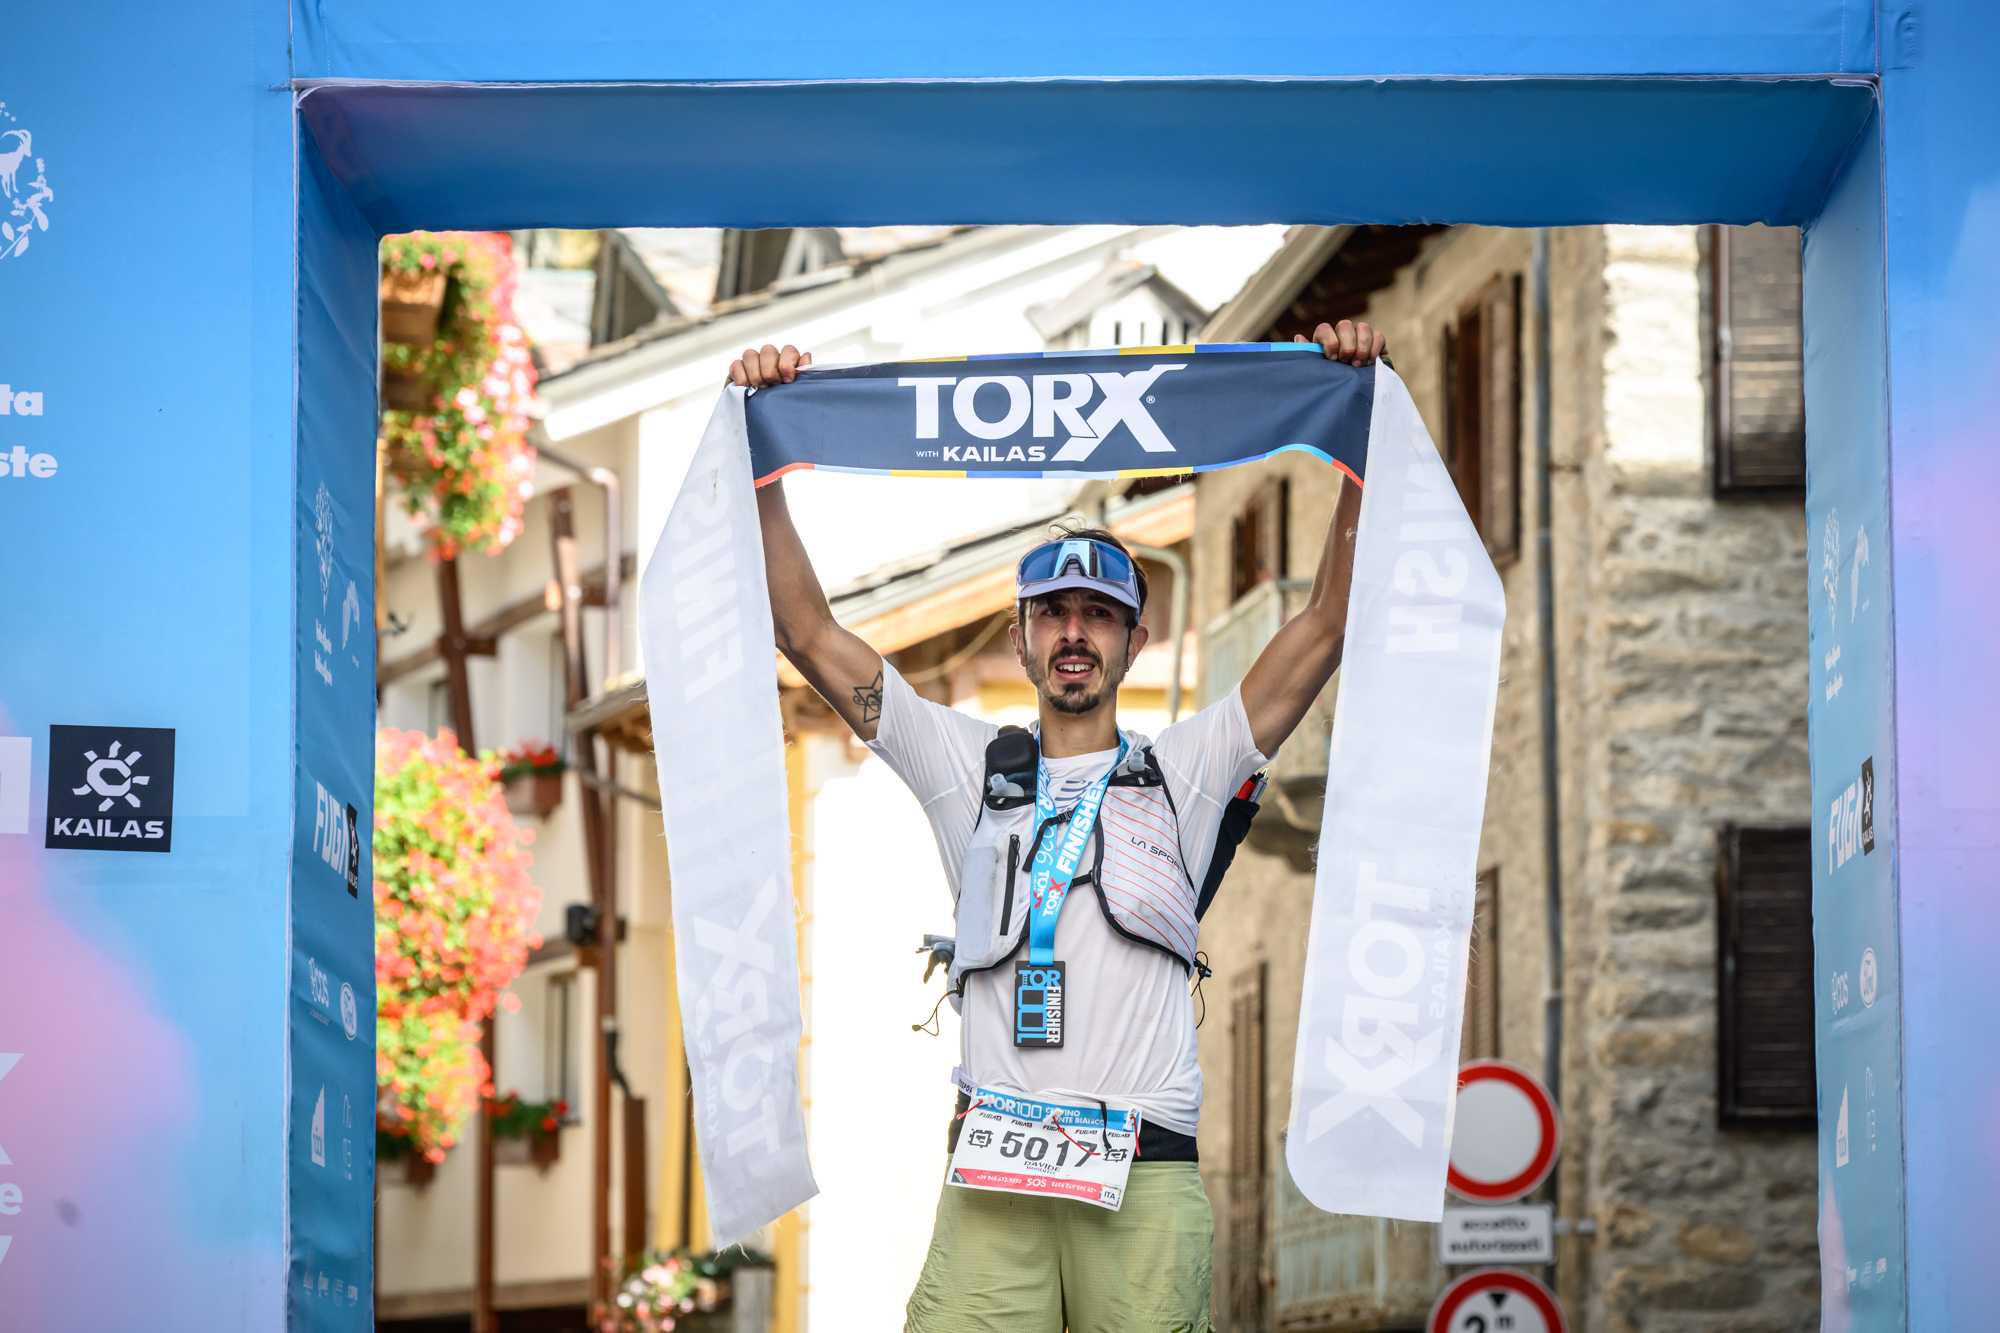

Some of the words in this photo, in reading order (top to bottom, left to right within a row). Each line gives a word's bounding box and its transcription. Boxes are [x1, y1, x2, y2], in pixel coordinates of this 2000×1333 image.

[915, 450, 939, 458] WITH
[943, 445, 1046, 462] KAILAS
[54, 817, 164, 839] KAILAS
[1131, 836, 1146, 849] LA
[1042, 876, 1067, 917] TORX
[1018, 970, 1061, 987] TOR
[1046, 986, 1062, 1043] FINISHER
[999, 1130, 1098, 1168] 5017
[1024, 1161, 1061, 1172] DAVIDE
[1026, 1178, 1047, 1188] SOS
[1104, 1191, 1115, 1200] ITA
